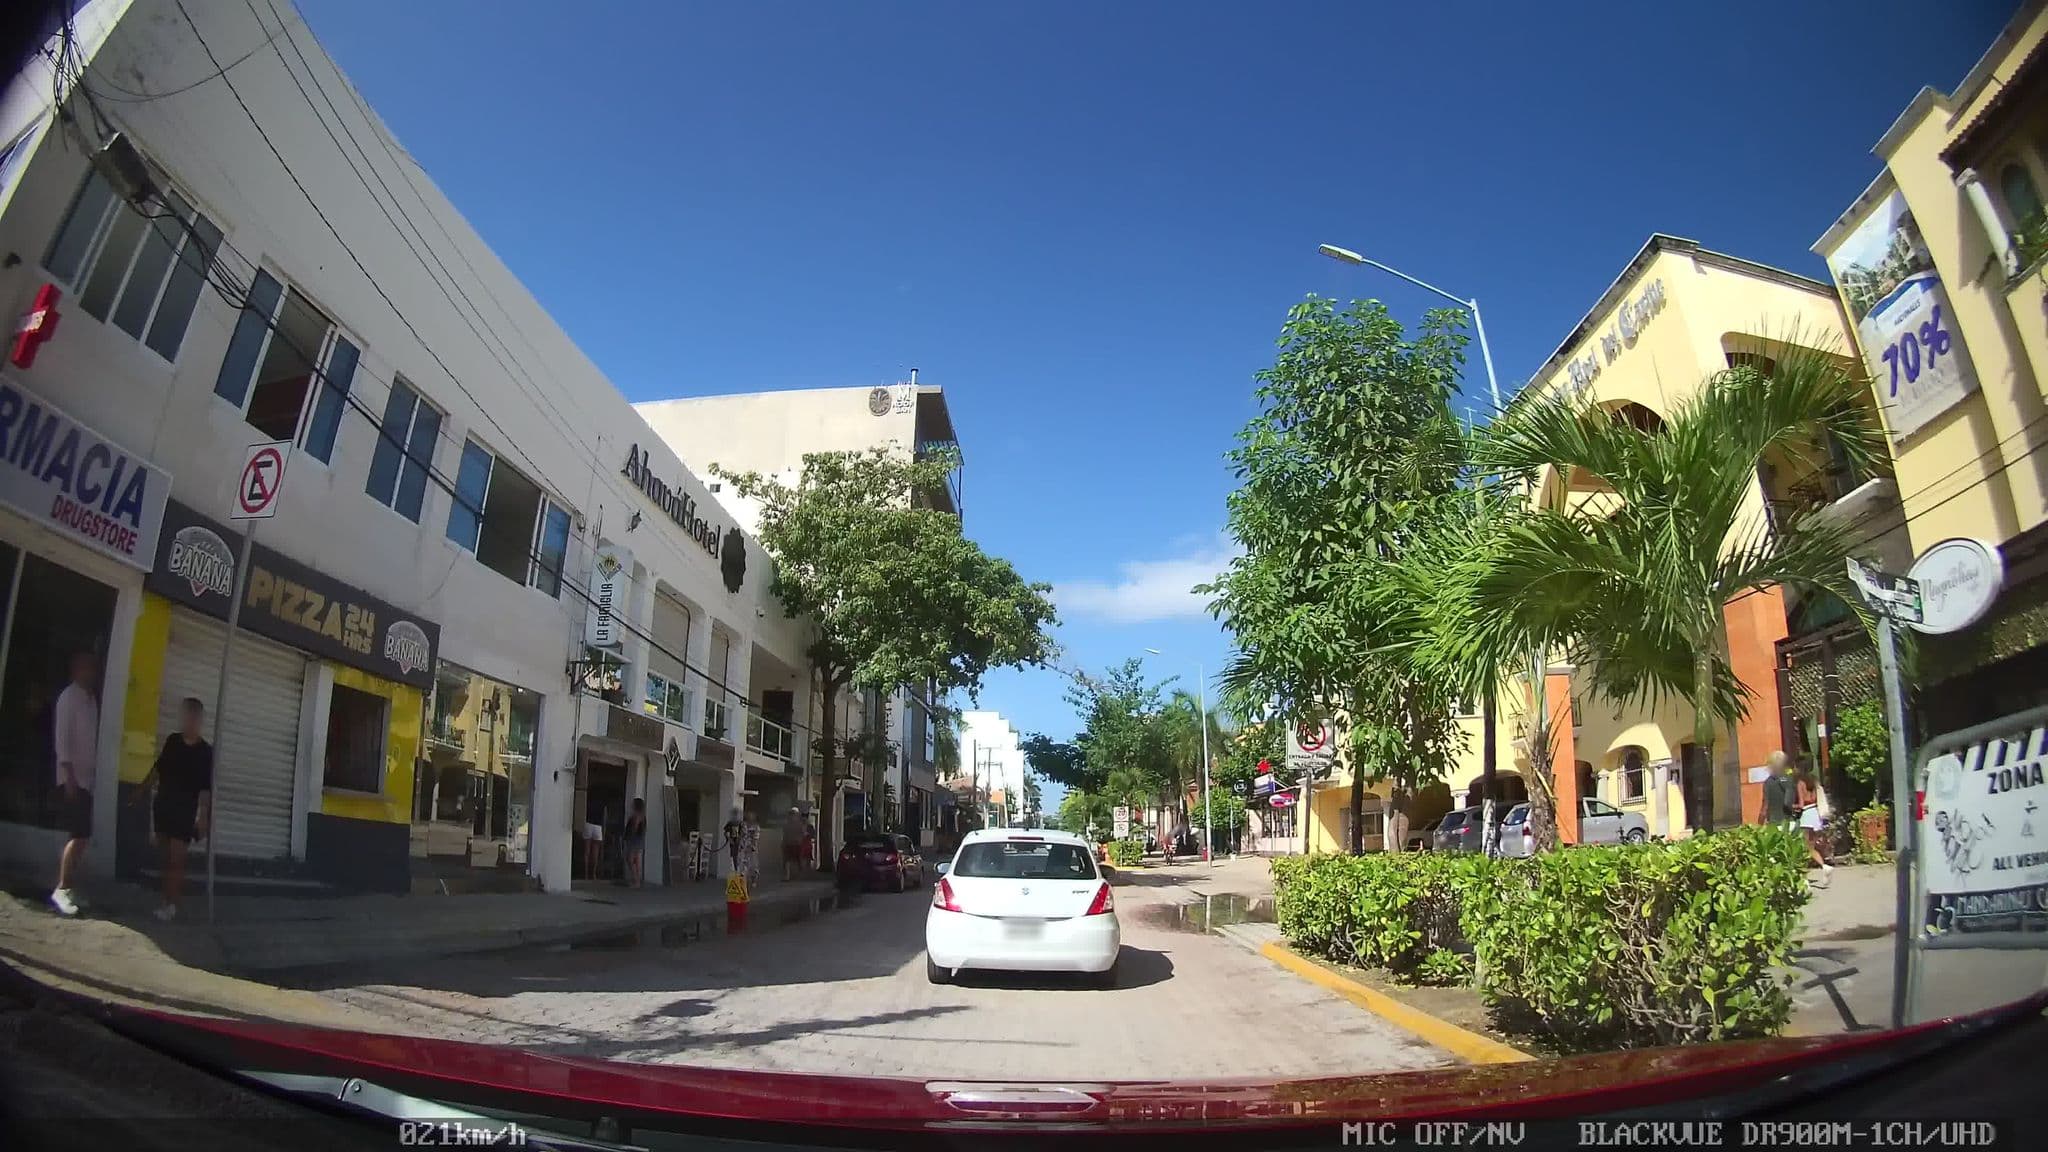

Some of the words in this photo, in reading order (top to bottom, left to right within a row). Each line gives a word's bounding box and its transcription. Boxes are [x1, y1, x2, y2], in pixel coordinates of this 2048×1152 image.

[52, 494, 138, 556] DRUGSTORE
[682, 491, 720, 559] Hotel
[168, 540, 234, 597] BANANA
[247, 566, 342, 641] PIZZA
[345, 603, 375, 637] 24
[598, 583, 613, 626] FAMIGLIA
[343, 629, 373, 655] HRS
[384, 634, 429, 673] BANANA
[596, 629, 609, 641] LA
[1987, 761, 2044, 795] ZONA
[1992, 857, 2014, 870] ALL
